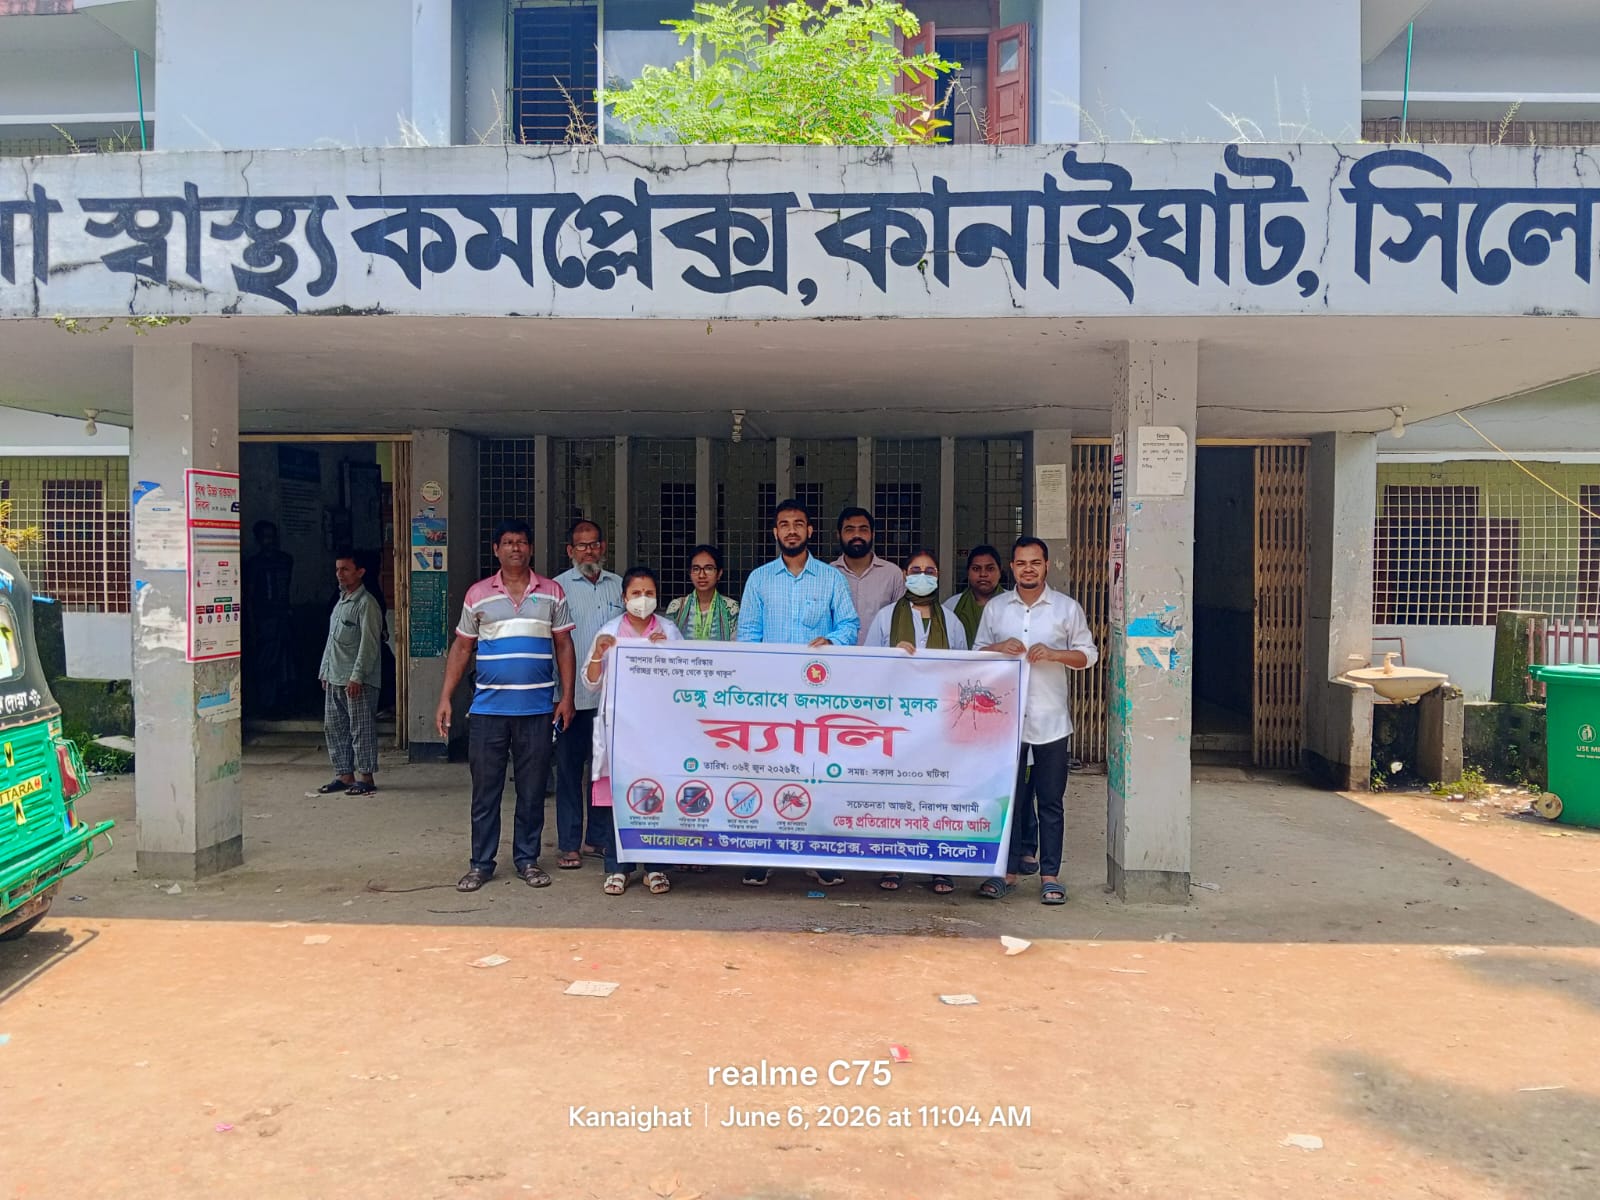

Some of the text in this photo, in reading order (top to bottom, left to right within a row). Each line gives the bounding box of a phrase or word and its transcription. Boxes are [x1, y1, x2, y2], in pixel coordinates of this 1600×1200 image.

[79, 181, 339, 313] স্বাস্থ্য
[346, 177, 818, 302] কমপ্লেক্স,
[809, 150, 1320, 304] কানাইঘাট,
[1339, 149, 1600, 294] সিলে
[673, 685, 938, 717] ডেঙ্গু প্রতিরোধে জনসচেতনতা মূলক
[752, 764, 765, 774] জুন
[872, 768, 894, 777] সকাল
[897, 770, 923, 778] ১০:০০
[926, 767, 950, 779] ঘটিকা
[847, 800, 979, 813] সচেতনতা আজই, নিরাপদ আগামী
[833, 813, 991, 832] ডেঙ্গু প্রতিরোধে সবাই এগিয়ে আসি
[640, 834, 703, 847] আয়োজনে
[718, 834, 771, 850] উপজেলা
[776, 838, 805, 854] স্বাস্থ্য
[809, 839, 865, 856] কমপ্লেক্স,
[869, 841, 933, 859] কানাইঘাট,
[938, 842, 978, 859] সিলেট
